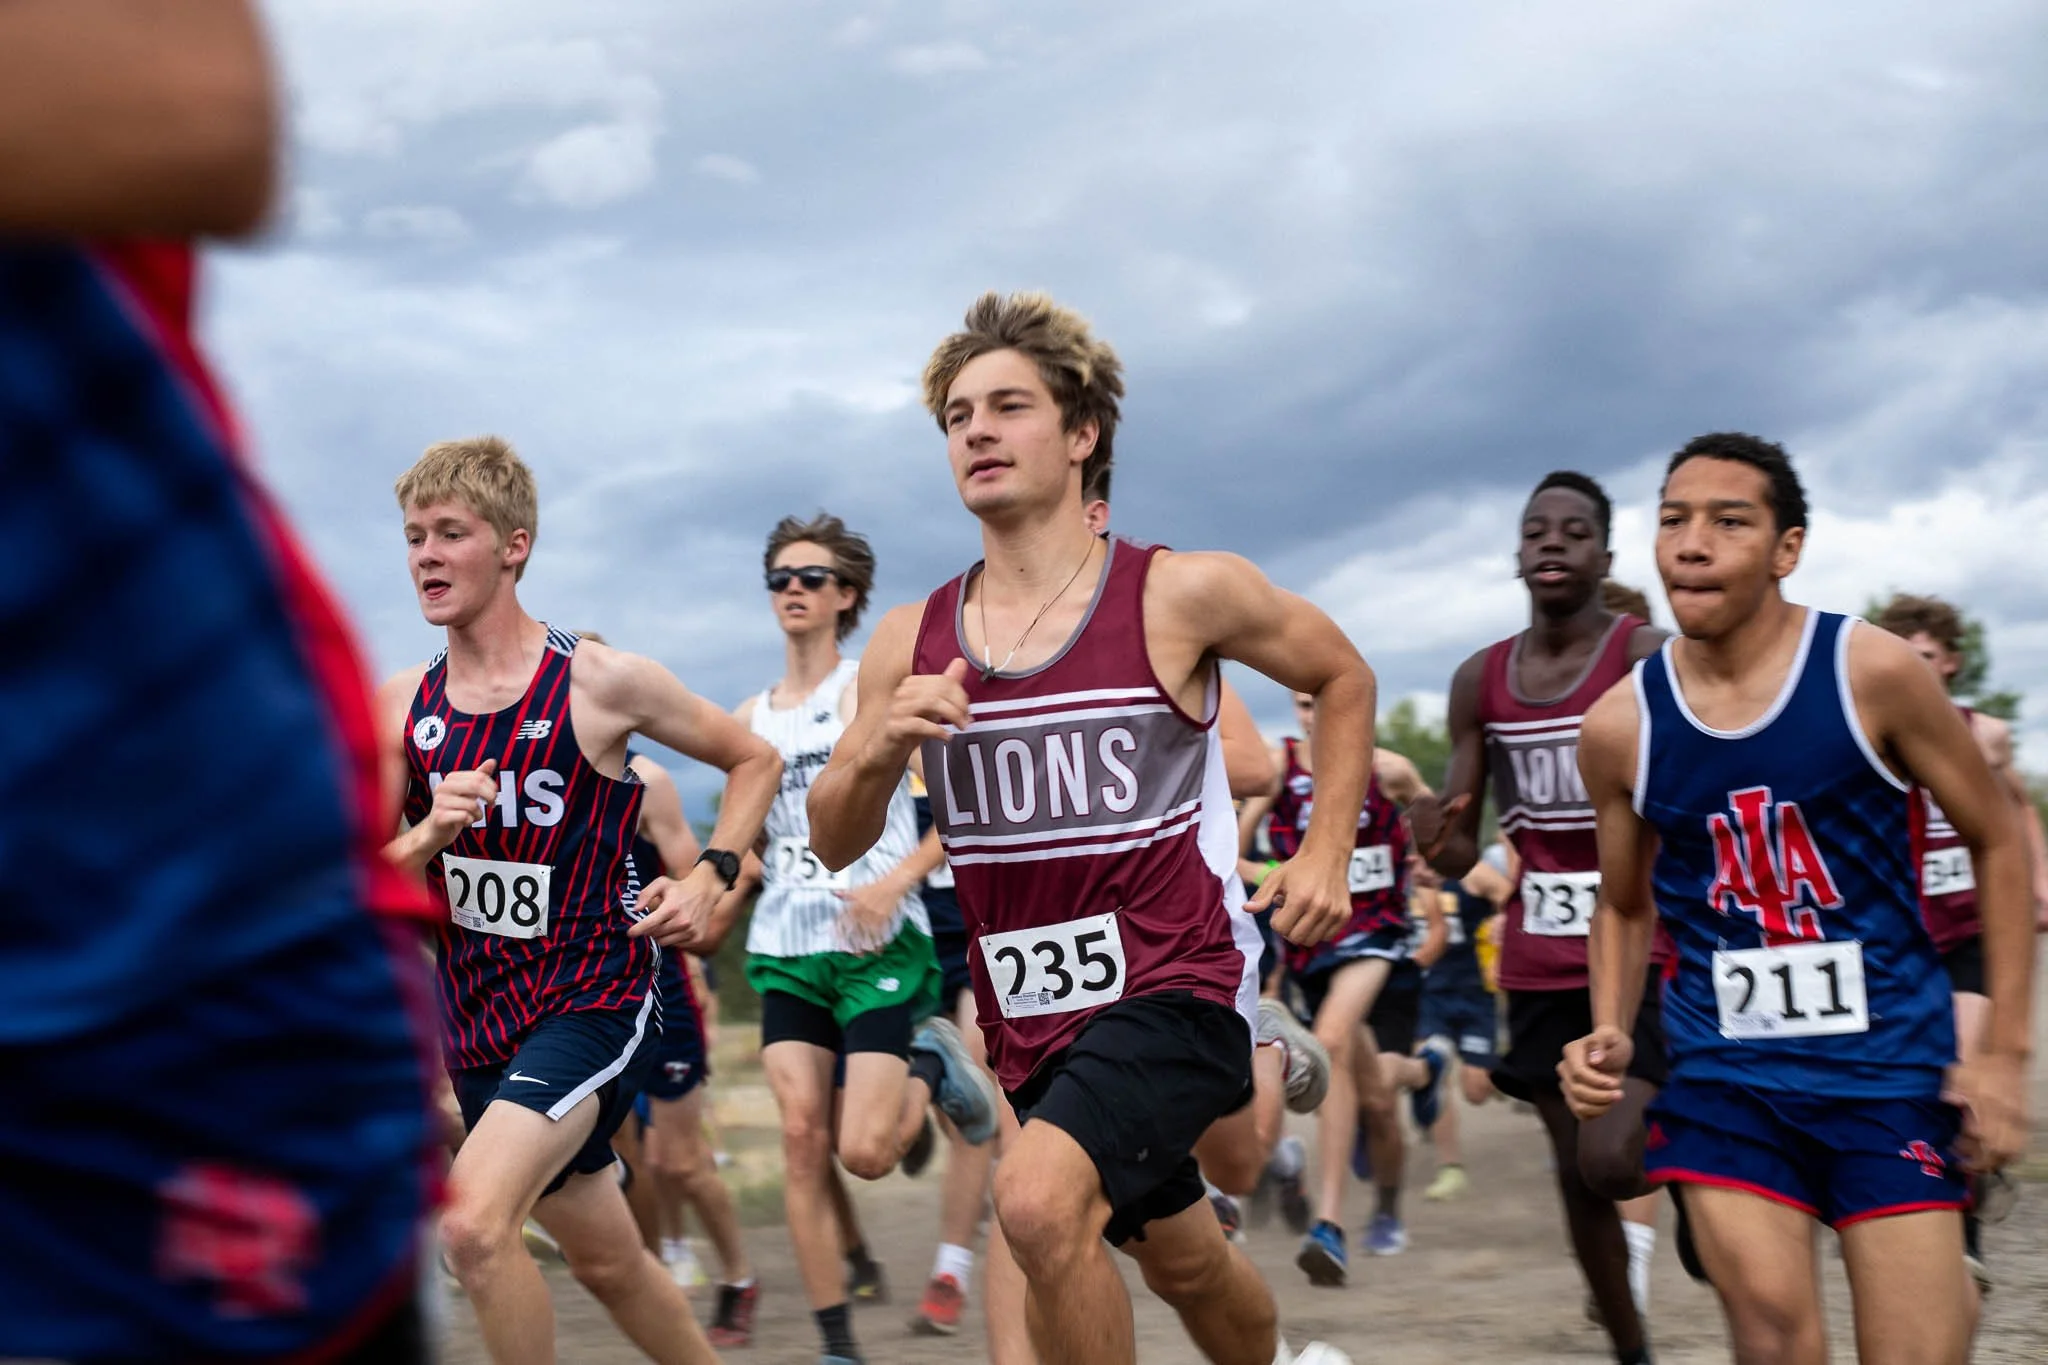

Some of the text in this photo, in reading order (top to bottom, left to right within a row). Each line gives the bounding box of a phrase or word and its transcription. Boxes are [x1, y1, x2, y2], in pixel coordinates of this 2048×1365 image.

[428, 769, 565, 828] HS
[943, 727, 1138, 827] LIONS
[780, 845, 834, 880] 25
[450, 868, 540, 927] 208
[994, 930, 1117, 1000] 235
[1725, 958, 1853, 1019] 211
